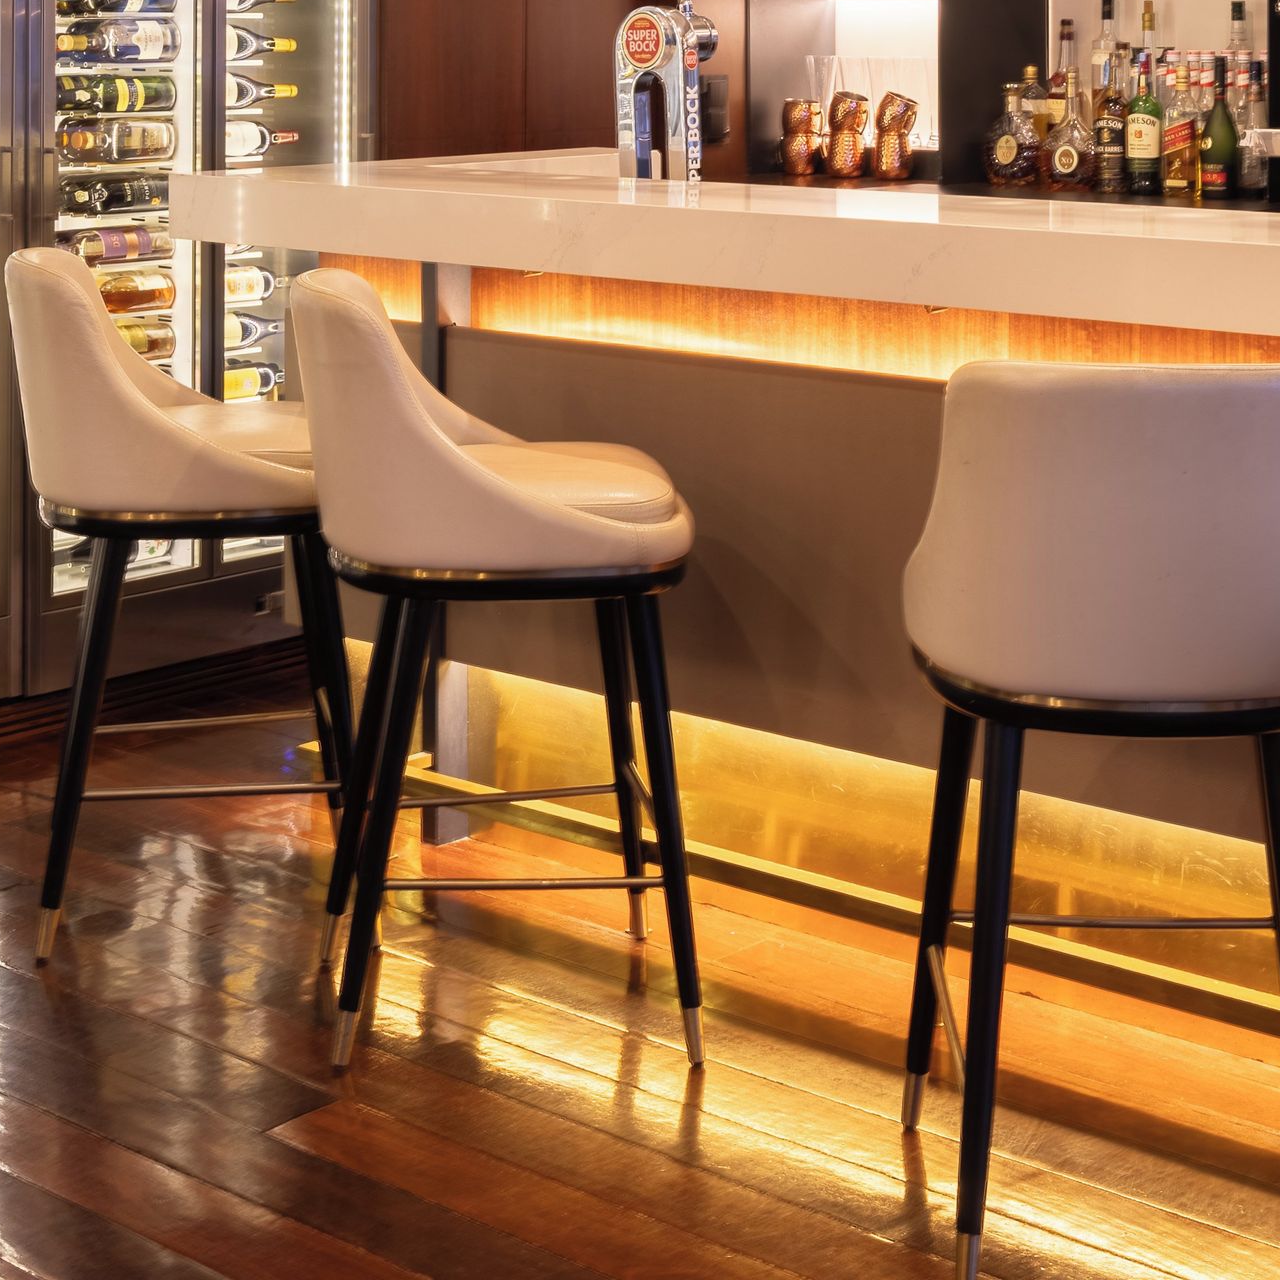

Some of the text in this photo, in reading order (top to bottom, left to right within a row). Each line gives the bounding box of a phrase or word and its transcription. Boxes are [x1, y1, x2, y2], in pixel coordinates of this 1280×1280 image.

[627, 29, 658, 41] SUPER
[629, 41, 657, 52] BOCK
[1129, 117, 1156, 127] AMESON
[686, 85, 701, 183] PER BOCK
